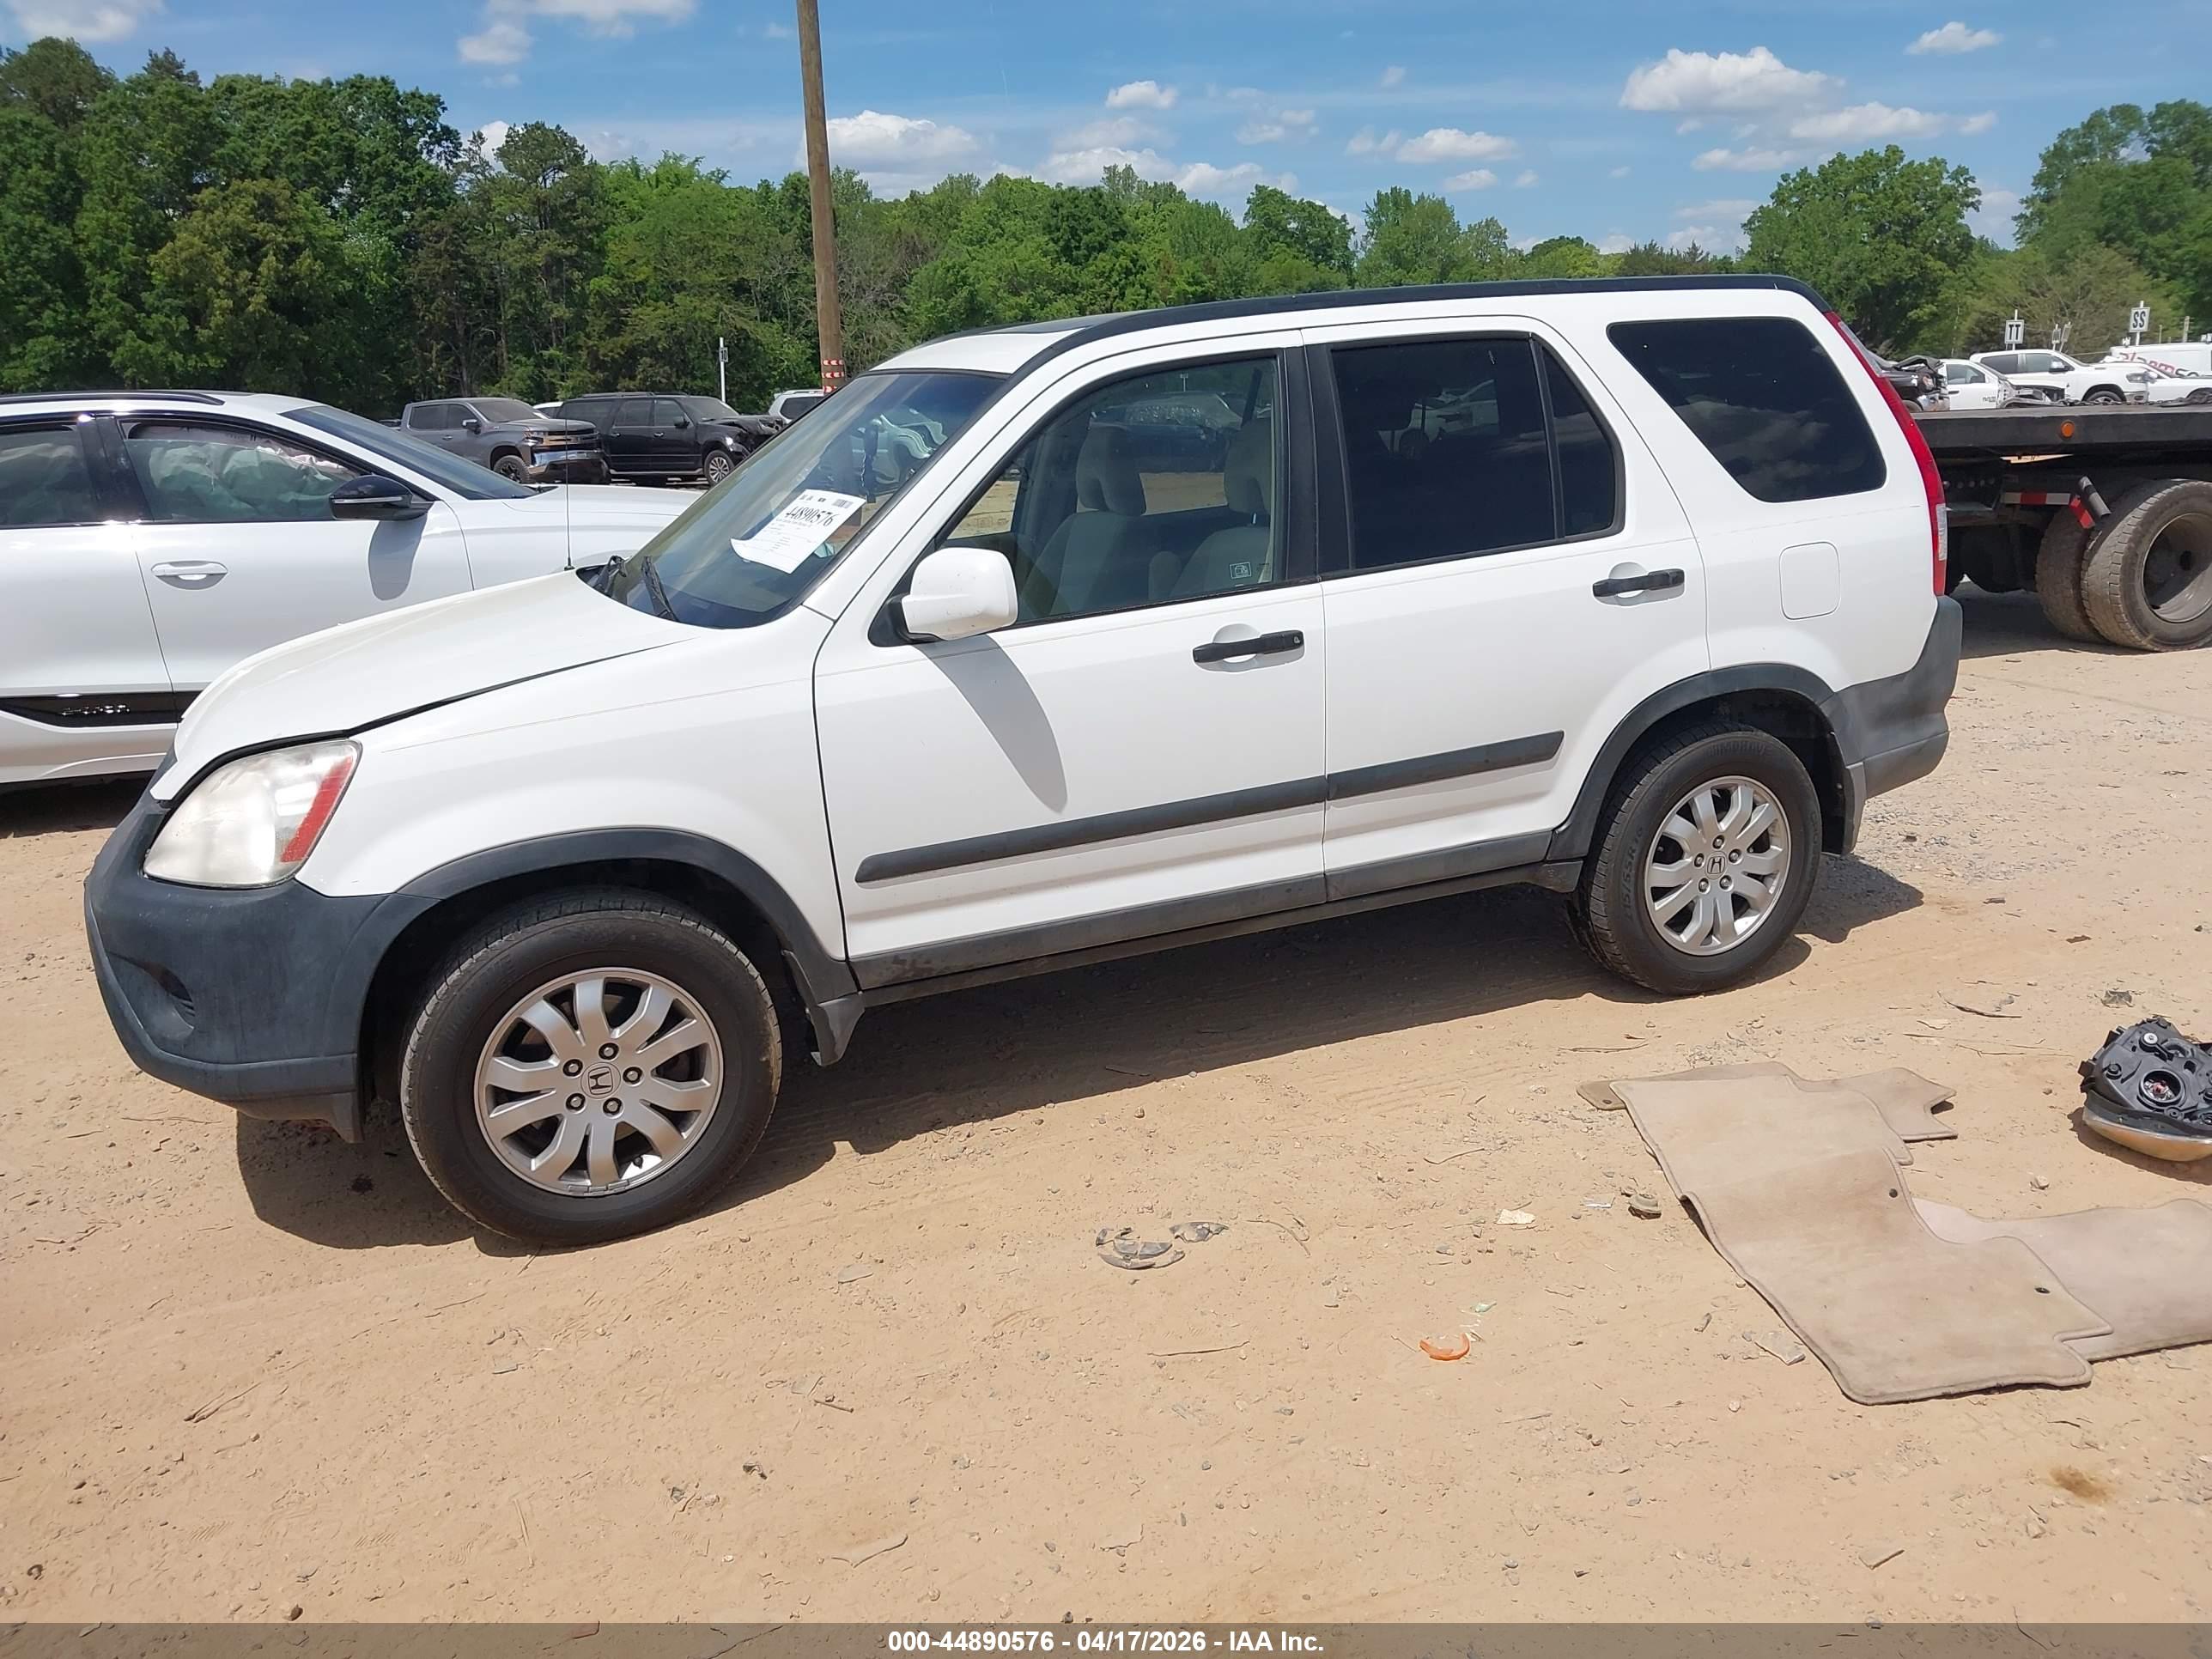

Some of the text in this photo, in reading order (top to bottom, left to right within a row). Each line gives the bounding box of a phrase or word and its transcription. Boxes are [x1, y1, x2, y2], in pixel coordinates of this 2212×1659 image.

[2132, 310, 2147, 329] SS
[2008, 323, 2021, 341] TT
[785, 506, 840, 527] 44890576
